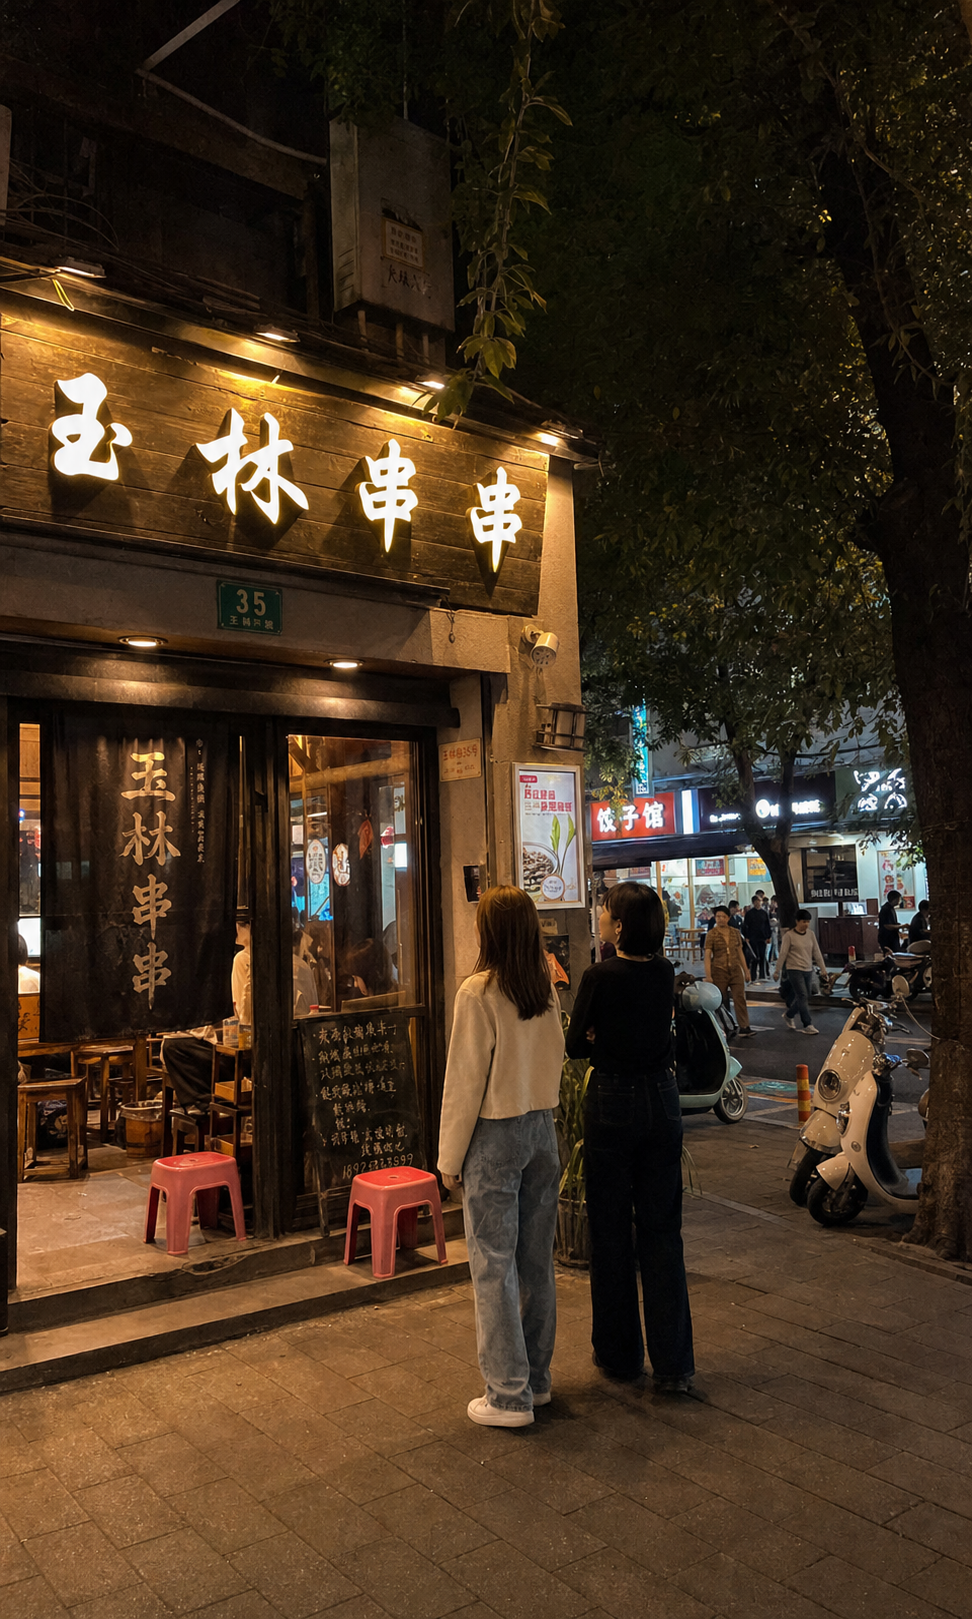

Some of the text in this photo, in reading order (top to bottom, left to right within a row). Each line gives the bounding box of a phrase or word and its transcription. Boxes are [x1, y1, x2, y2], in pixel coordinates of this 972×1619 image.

[50, 373, 523, 573] 玉林串串
[236, 589, 266, 616] 35
[597, 801, 664, 833] 饺子馆
[119, 751, 181, 1011] 玉林串串
